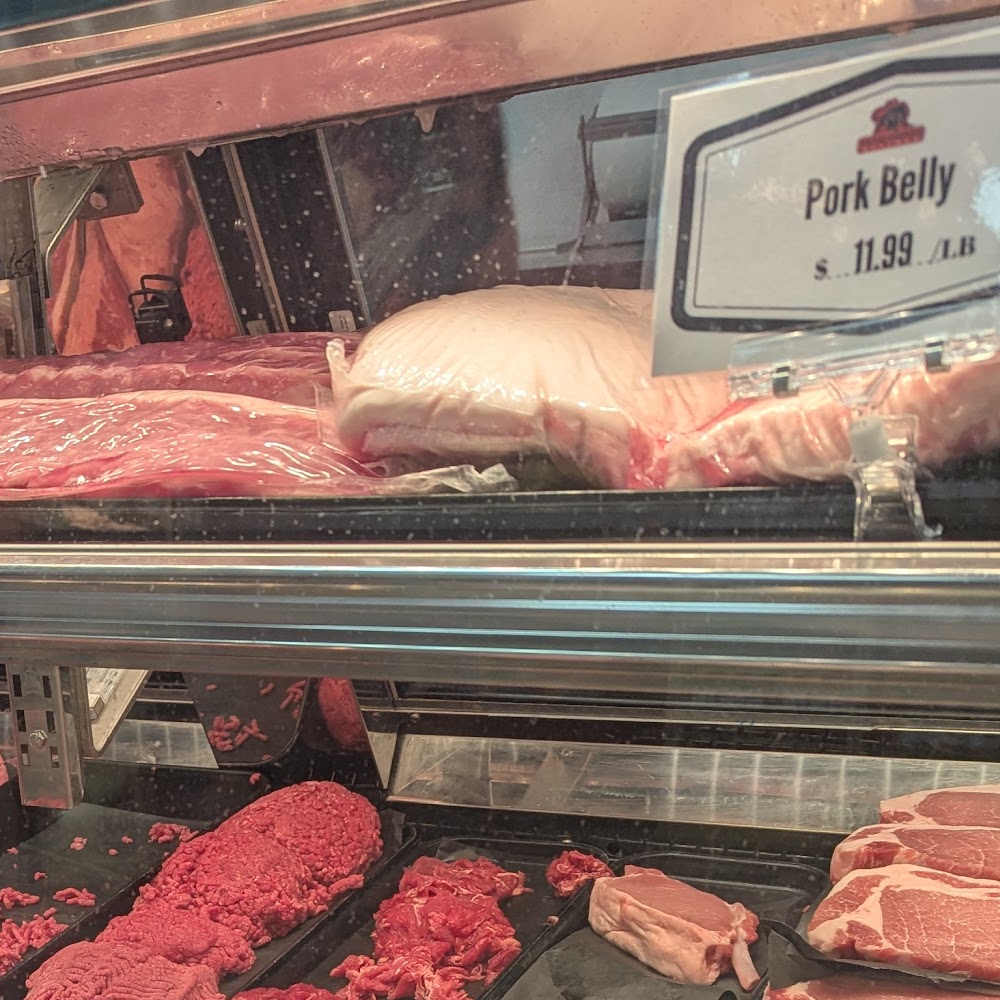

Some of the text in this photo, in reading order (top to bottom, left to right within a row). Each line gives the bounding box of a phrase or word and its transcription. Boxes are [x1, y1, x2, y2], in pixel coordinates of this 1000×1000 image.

[804, 156, 956, 220] Pork Belly
[854, 231, 913, 275] 11.99
